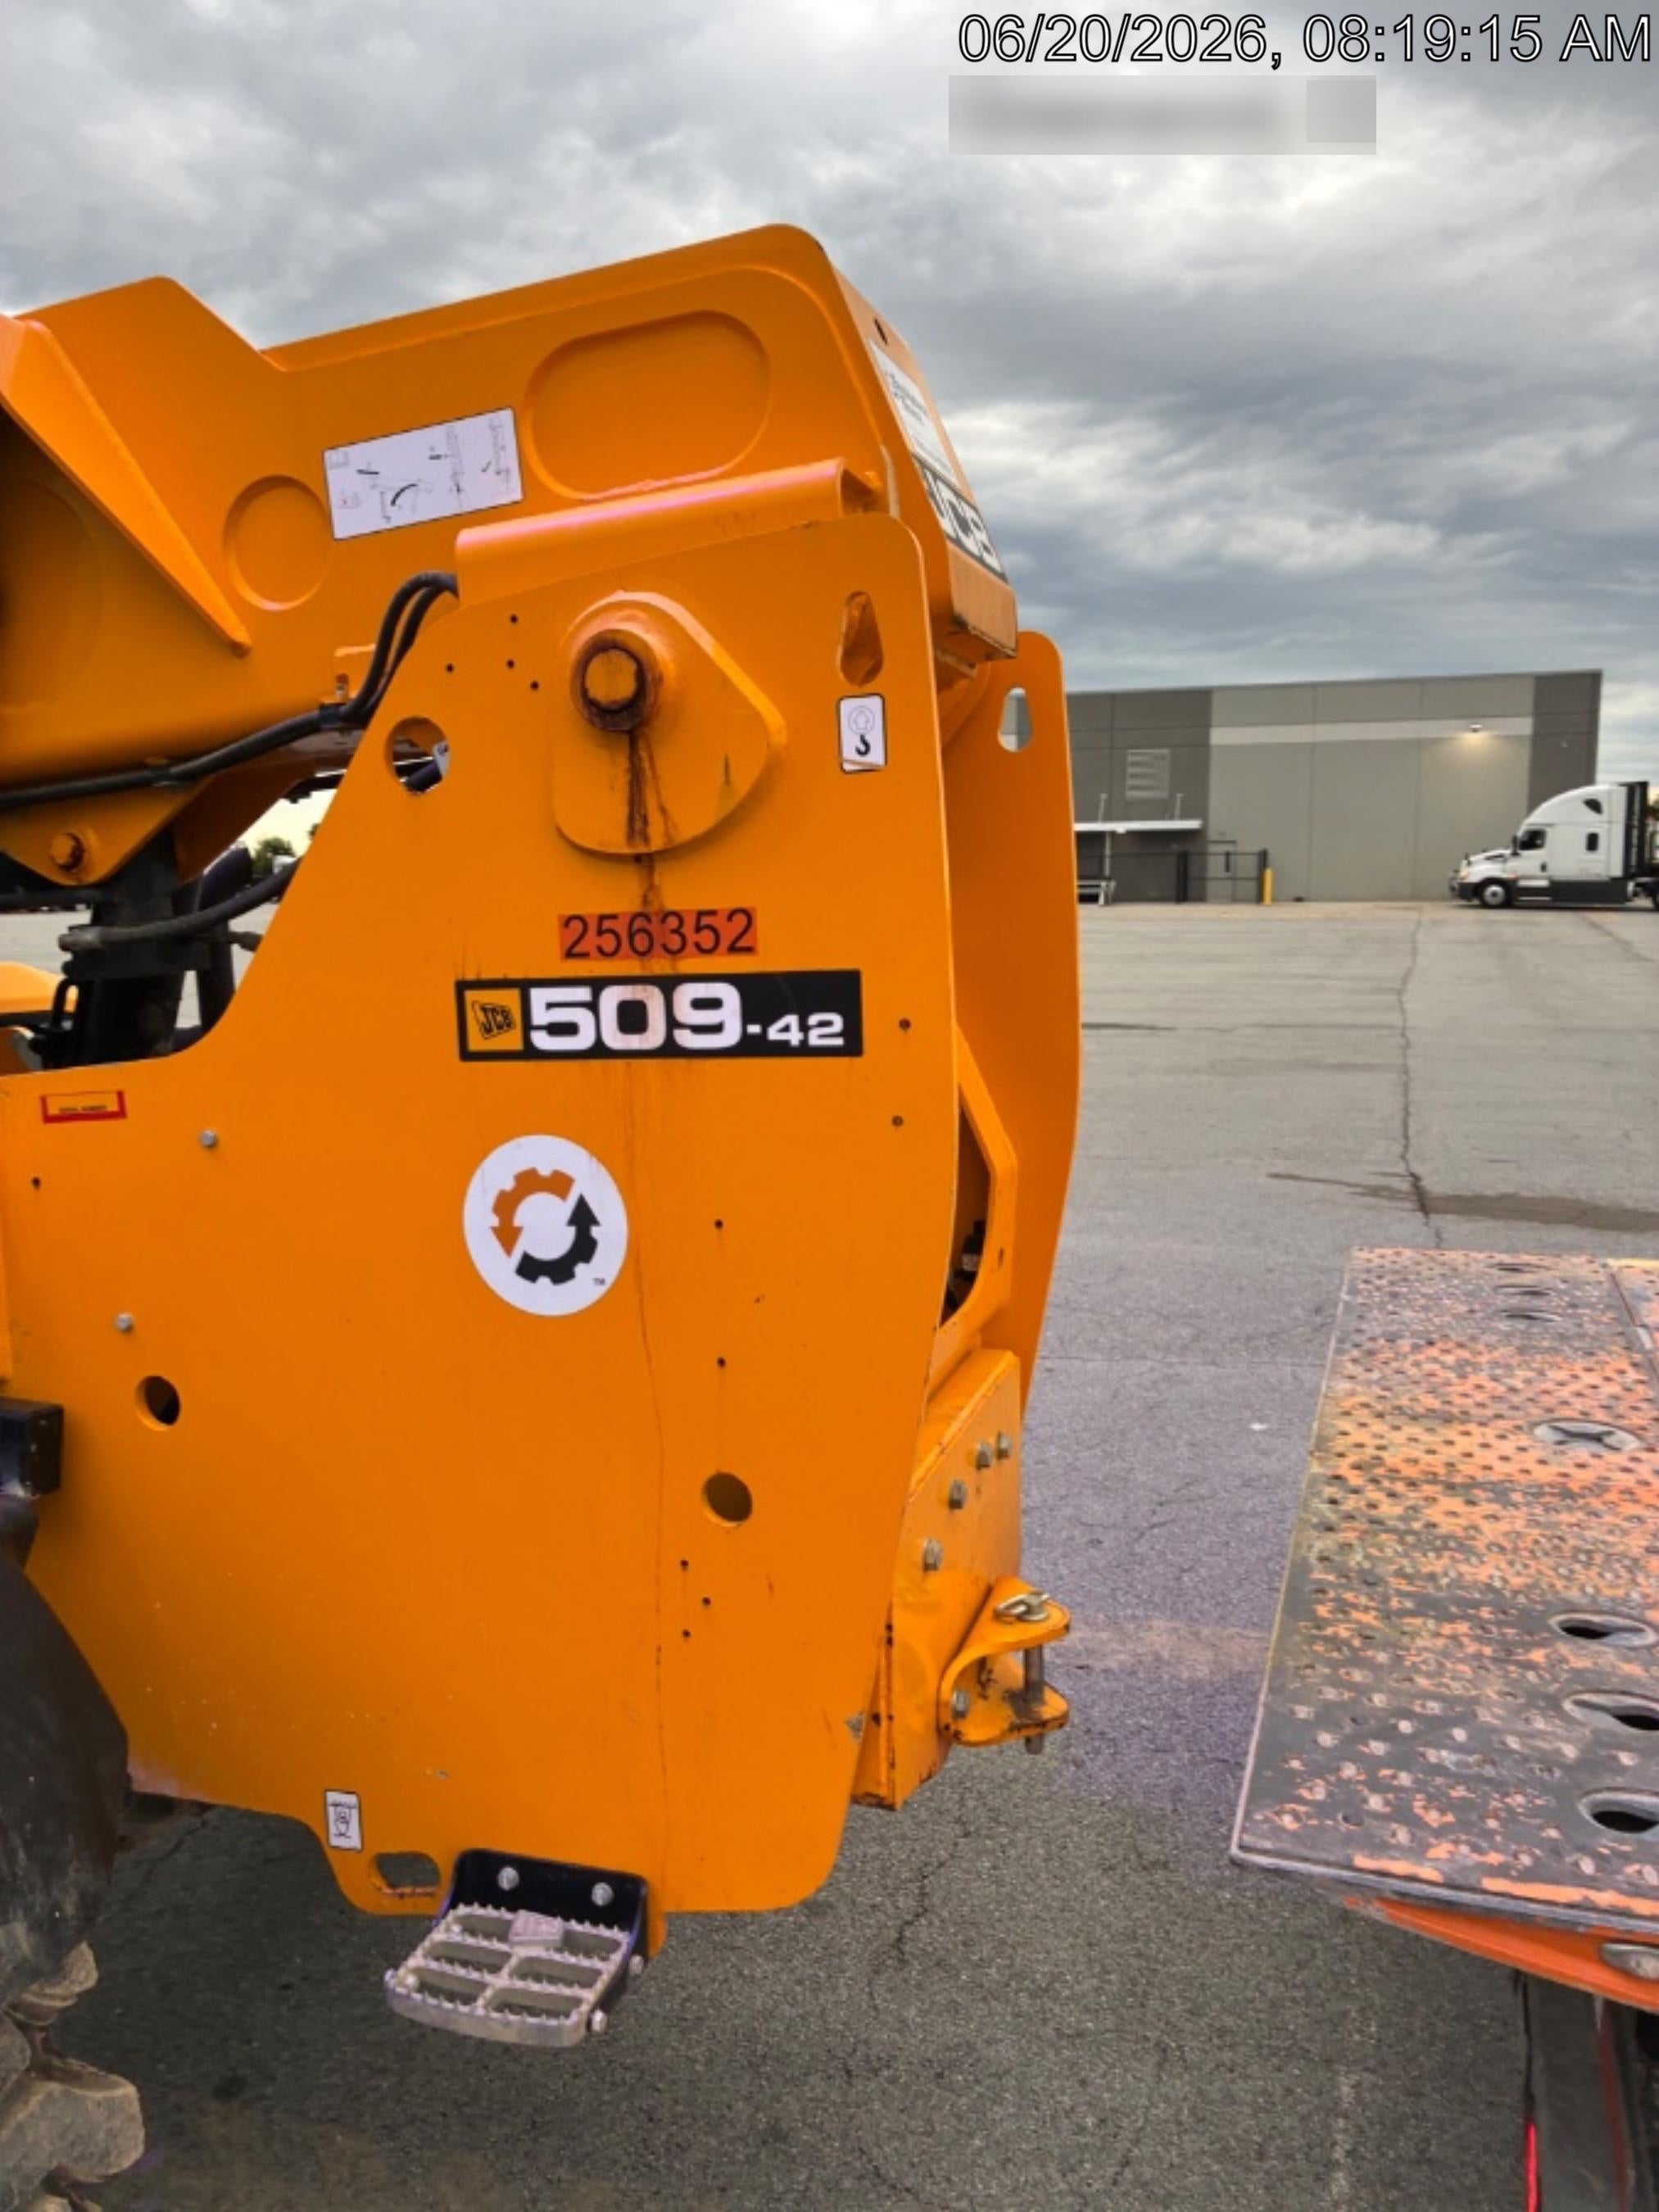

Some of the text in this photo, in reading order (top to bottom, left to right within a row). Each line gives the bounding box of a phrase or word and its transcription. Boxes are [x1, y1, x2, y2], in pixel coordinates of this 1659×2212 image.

[563, 907, 755, 959] 256352
[474, 981, 845, 1050] JCB 509-42
